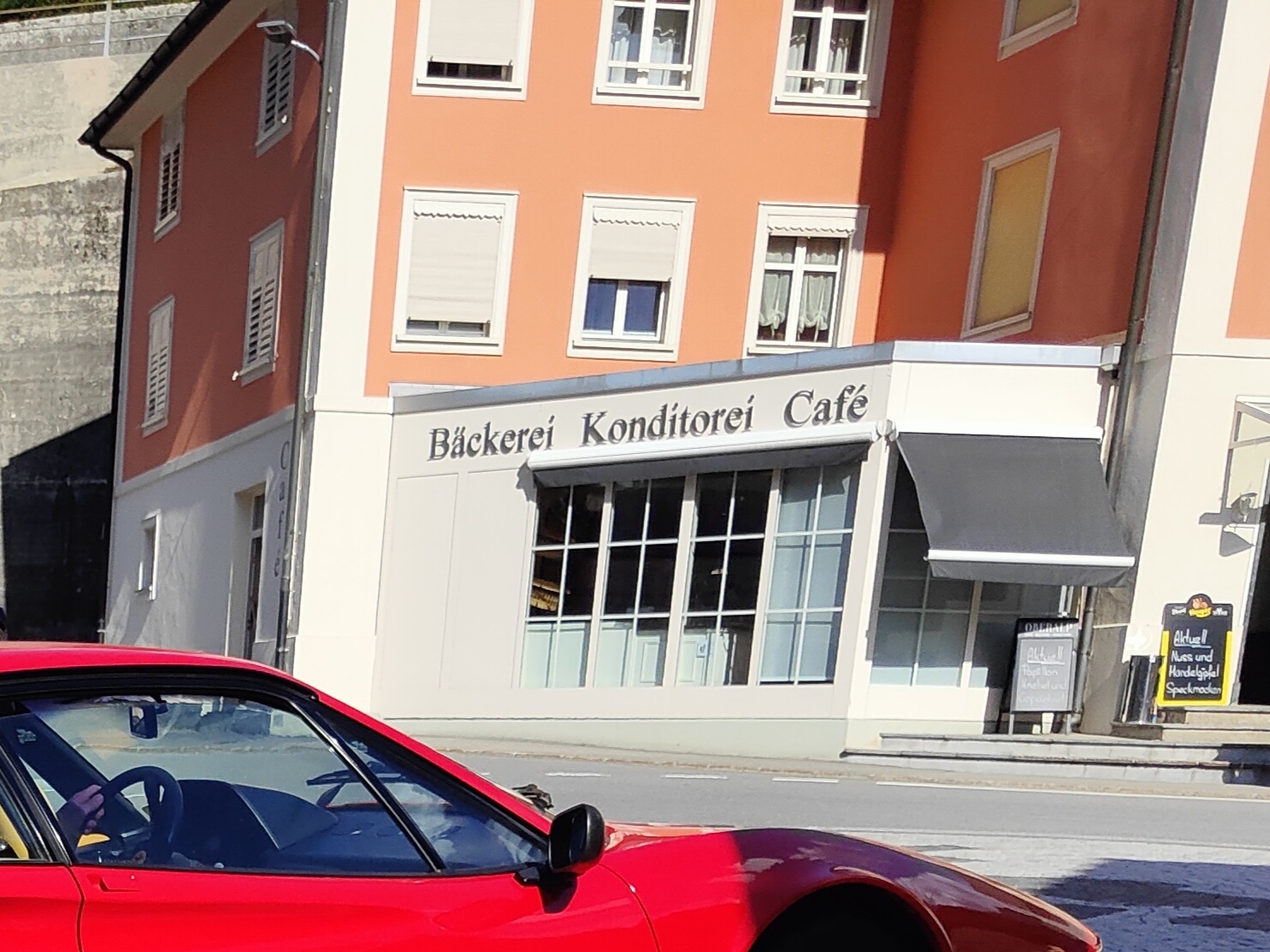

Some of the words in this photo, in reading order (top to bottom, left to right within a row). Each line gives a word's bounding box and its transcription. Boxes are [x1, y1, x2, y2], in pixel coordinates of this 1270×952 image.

[427, 416, 556, 462] Bäckerei
[580, 394, 756, 448] Konditorei
[784, 383, 870, 428] Café
[1025, 622, 1073, 633] OBERALP
[1173, 628, 1208, 645] Aktuell
[1171, 649, 1194, 662] Nuss
[1195, 649, 1214, 662] und
